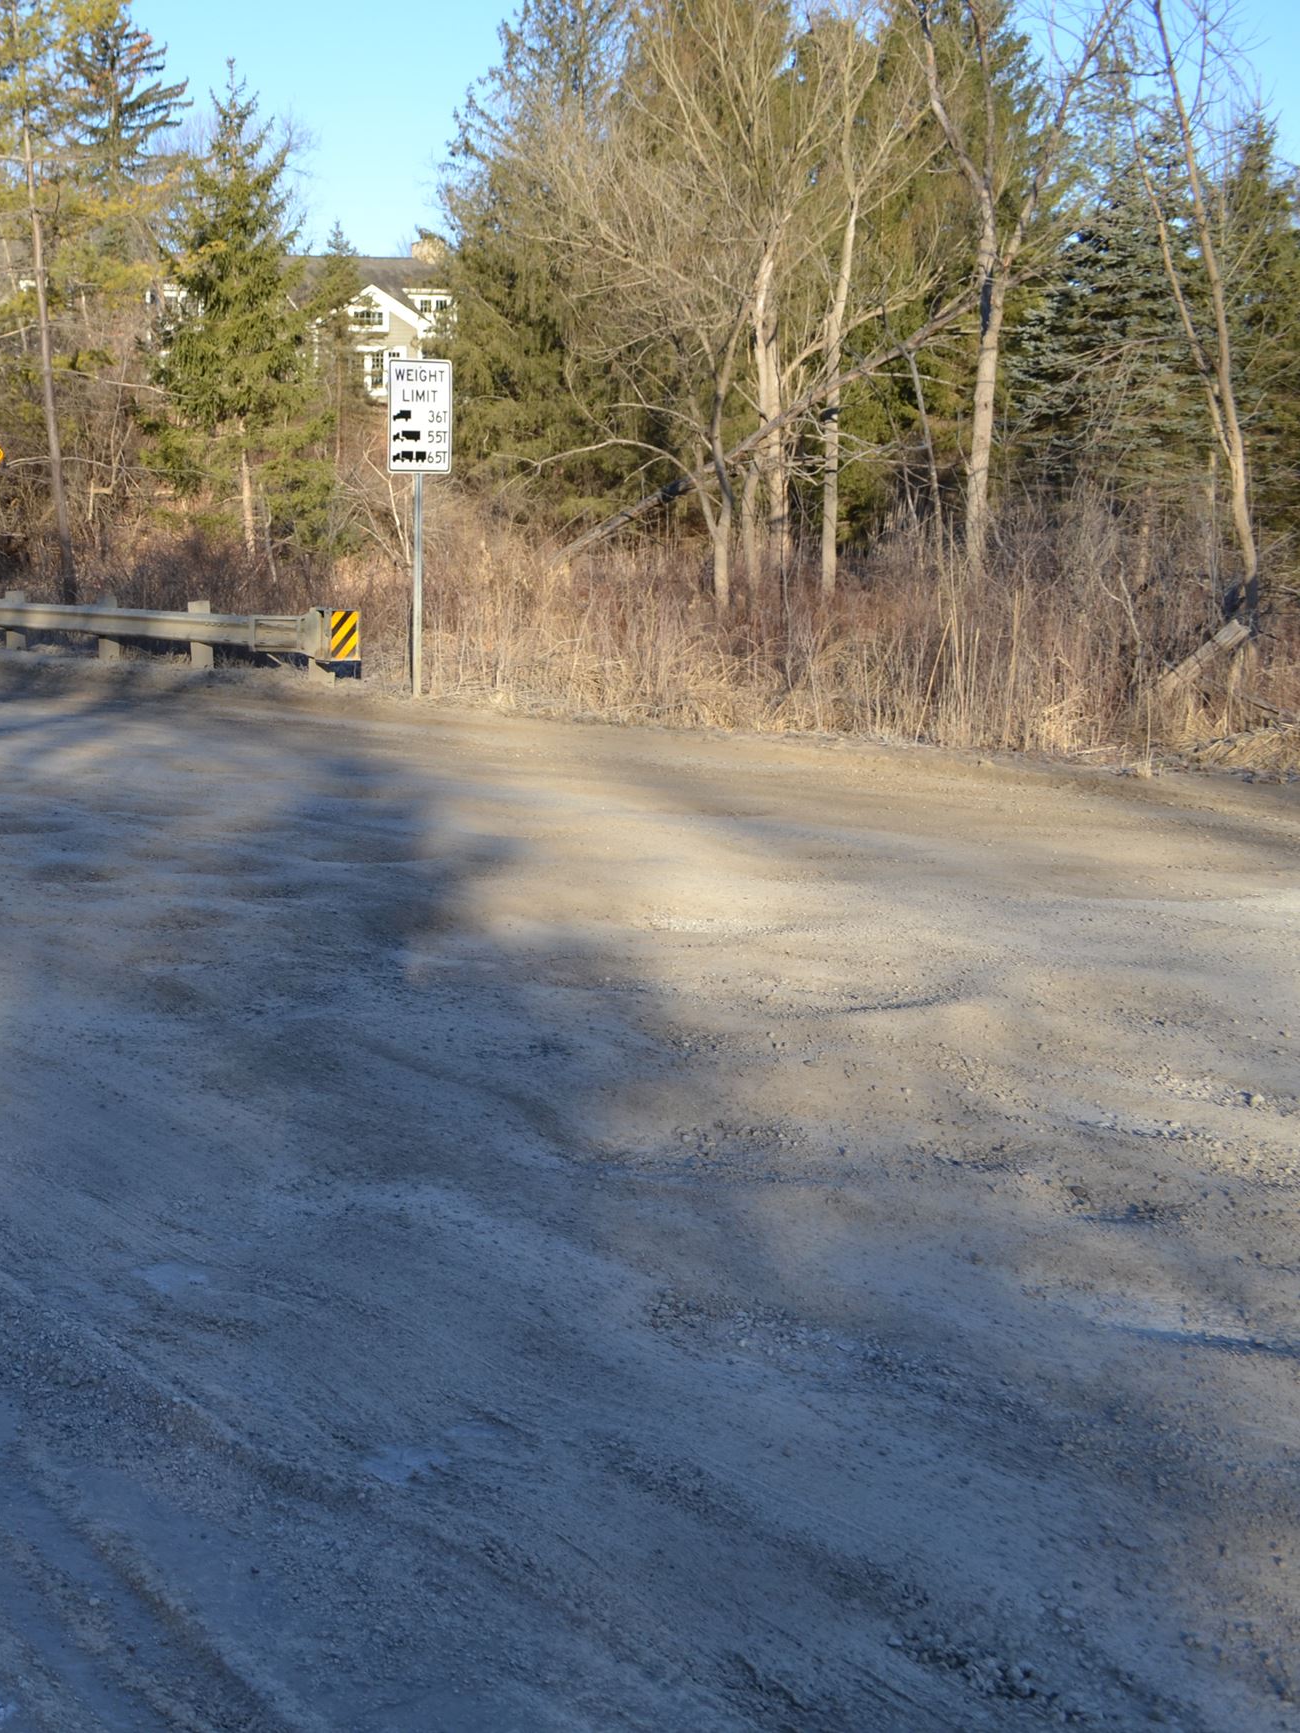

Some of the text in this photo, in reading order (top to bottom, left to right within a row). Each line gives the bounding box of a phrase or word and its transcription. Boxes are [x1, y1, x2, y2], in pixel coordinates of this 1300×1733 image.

[395, 368, 444, 382] WEIGHT
[402, 389, 438, 402] LIMIT
[428, 410, 448, 423] 36T
[428, 431, 448, 443] 55T
[427, 451, 448, 464] 65T
